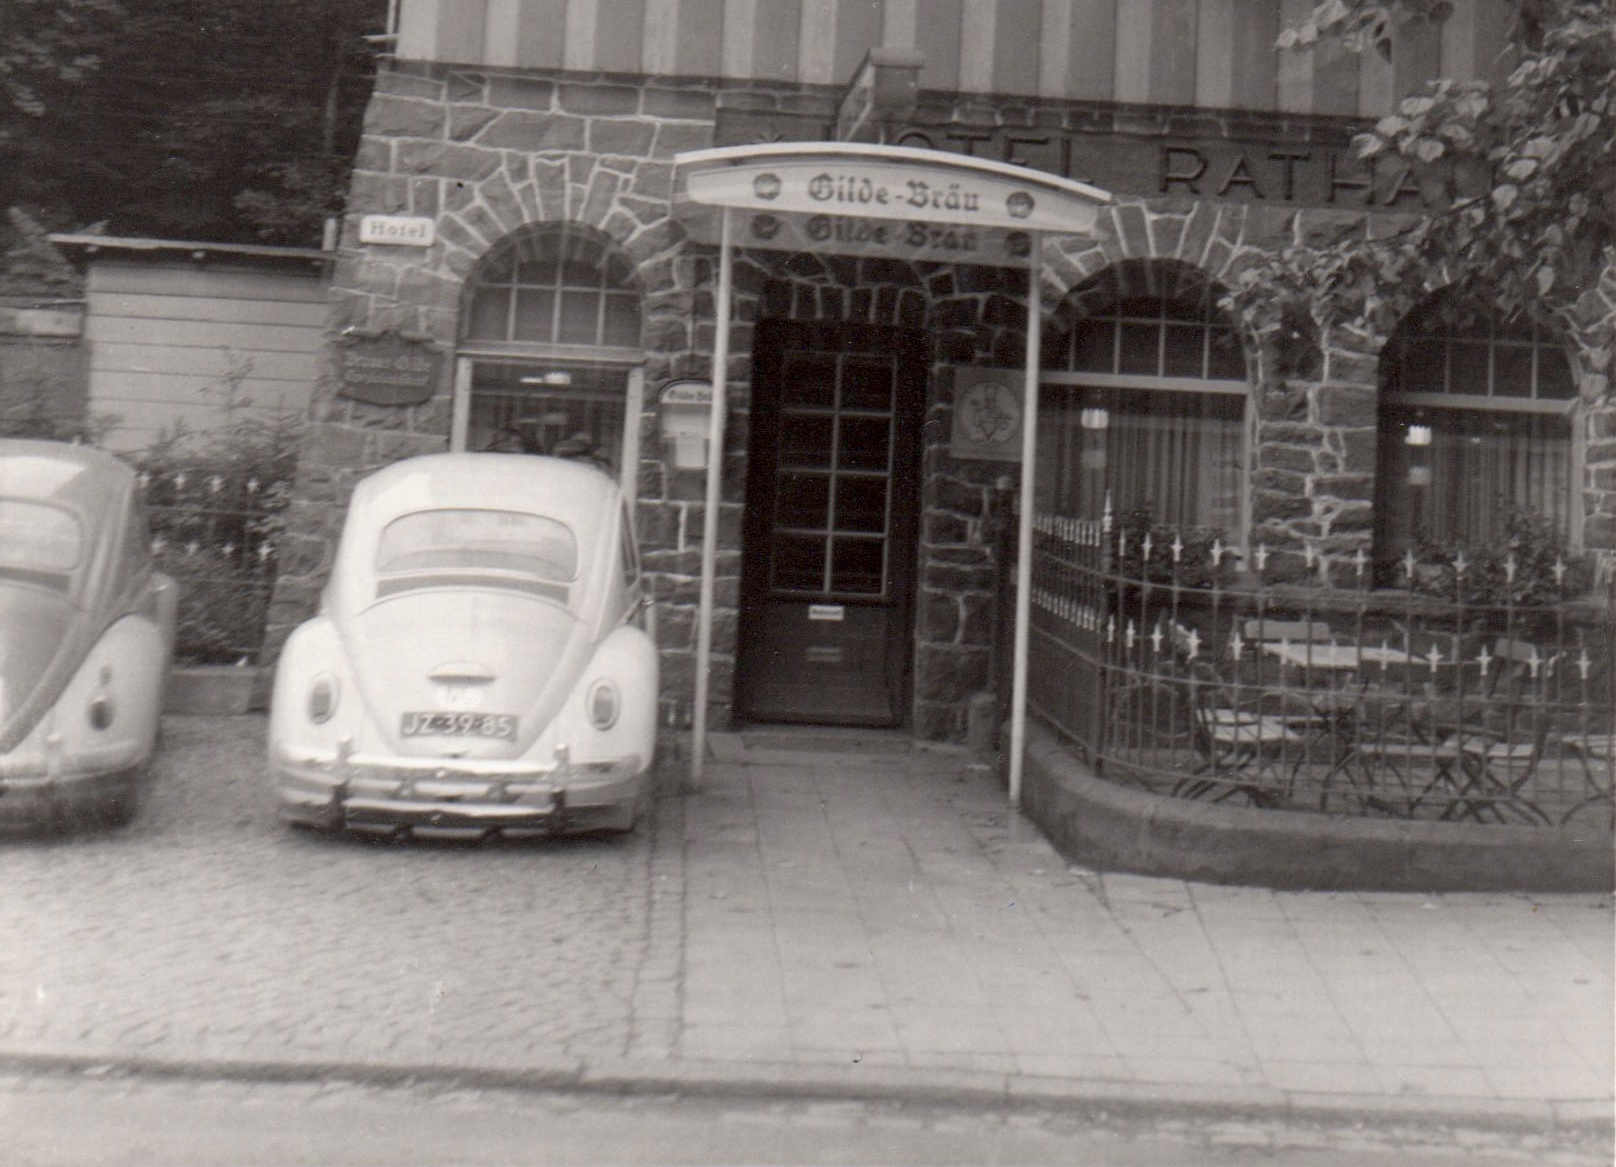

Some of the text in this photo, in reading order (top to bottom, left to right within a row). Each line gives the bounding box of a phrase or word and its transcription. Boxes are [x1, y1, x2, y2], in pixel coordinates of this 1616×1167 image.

[808, 172, 981, 212] Gilde-Bräu
[370, 220, 426, 239] Hotel
[403, 713, 513, 738] JZ-39-85
